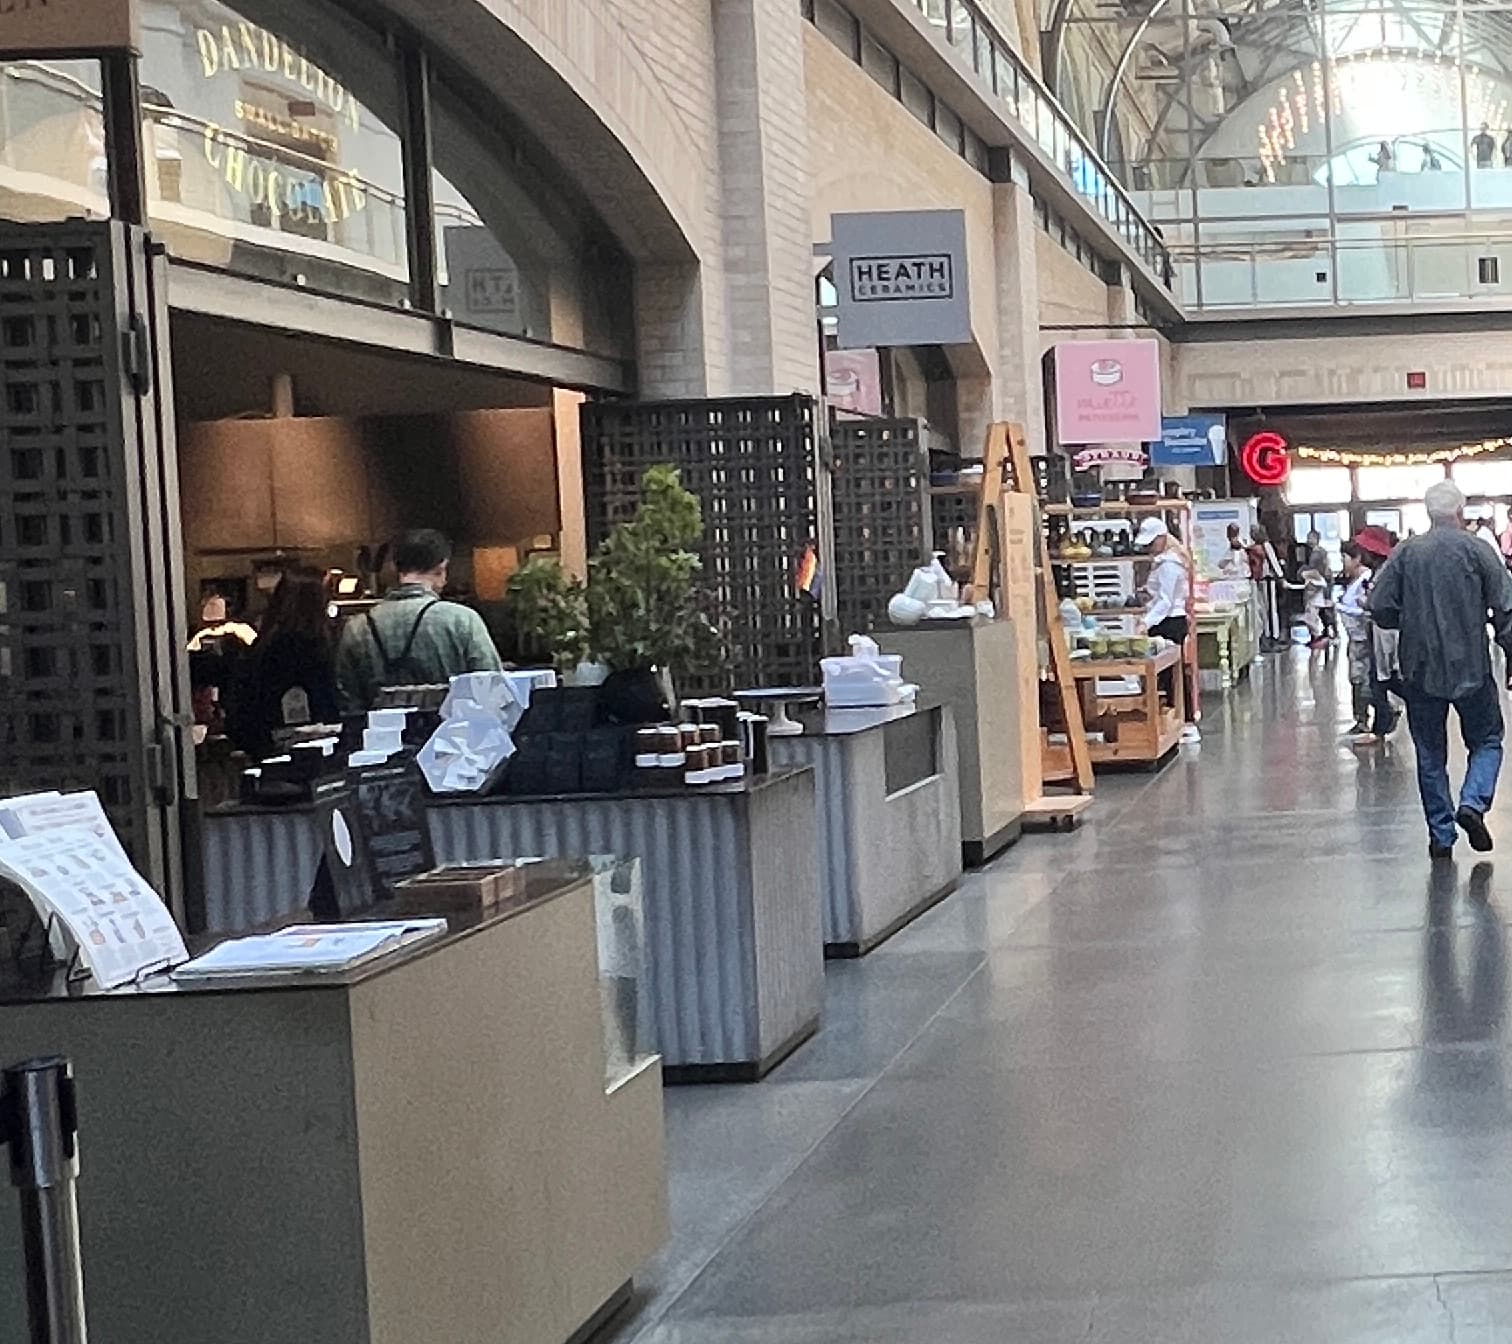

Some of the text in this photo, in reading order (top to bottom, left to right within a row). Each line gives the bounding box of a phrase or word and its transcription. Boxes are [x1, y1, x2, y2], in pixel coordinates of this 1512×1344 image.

[857, 261, 945, 282] HEATH
[859, 282, 947, 296] CERAMICS
[1243, 432, 1291, 484] G
